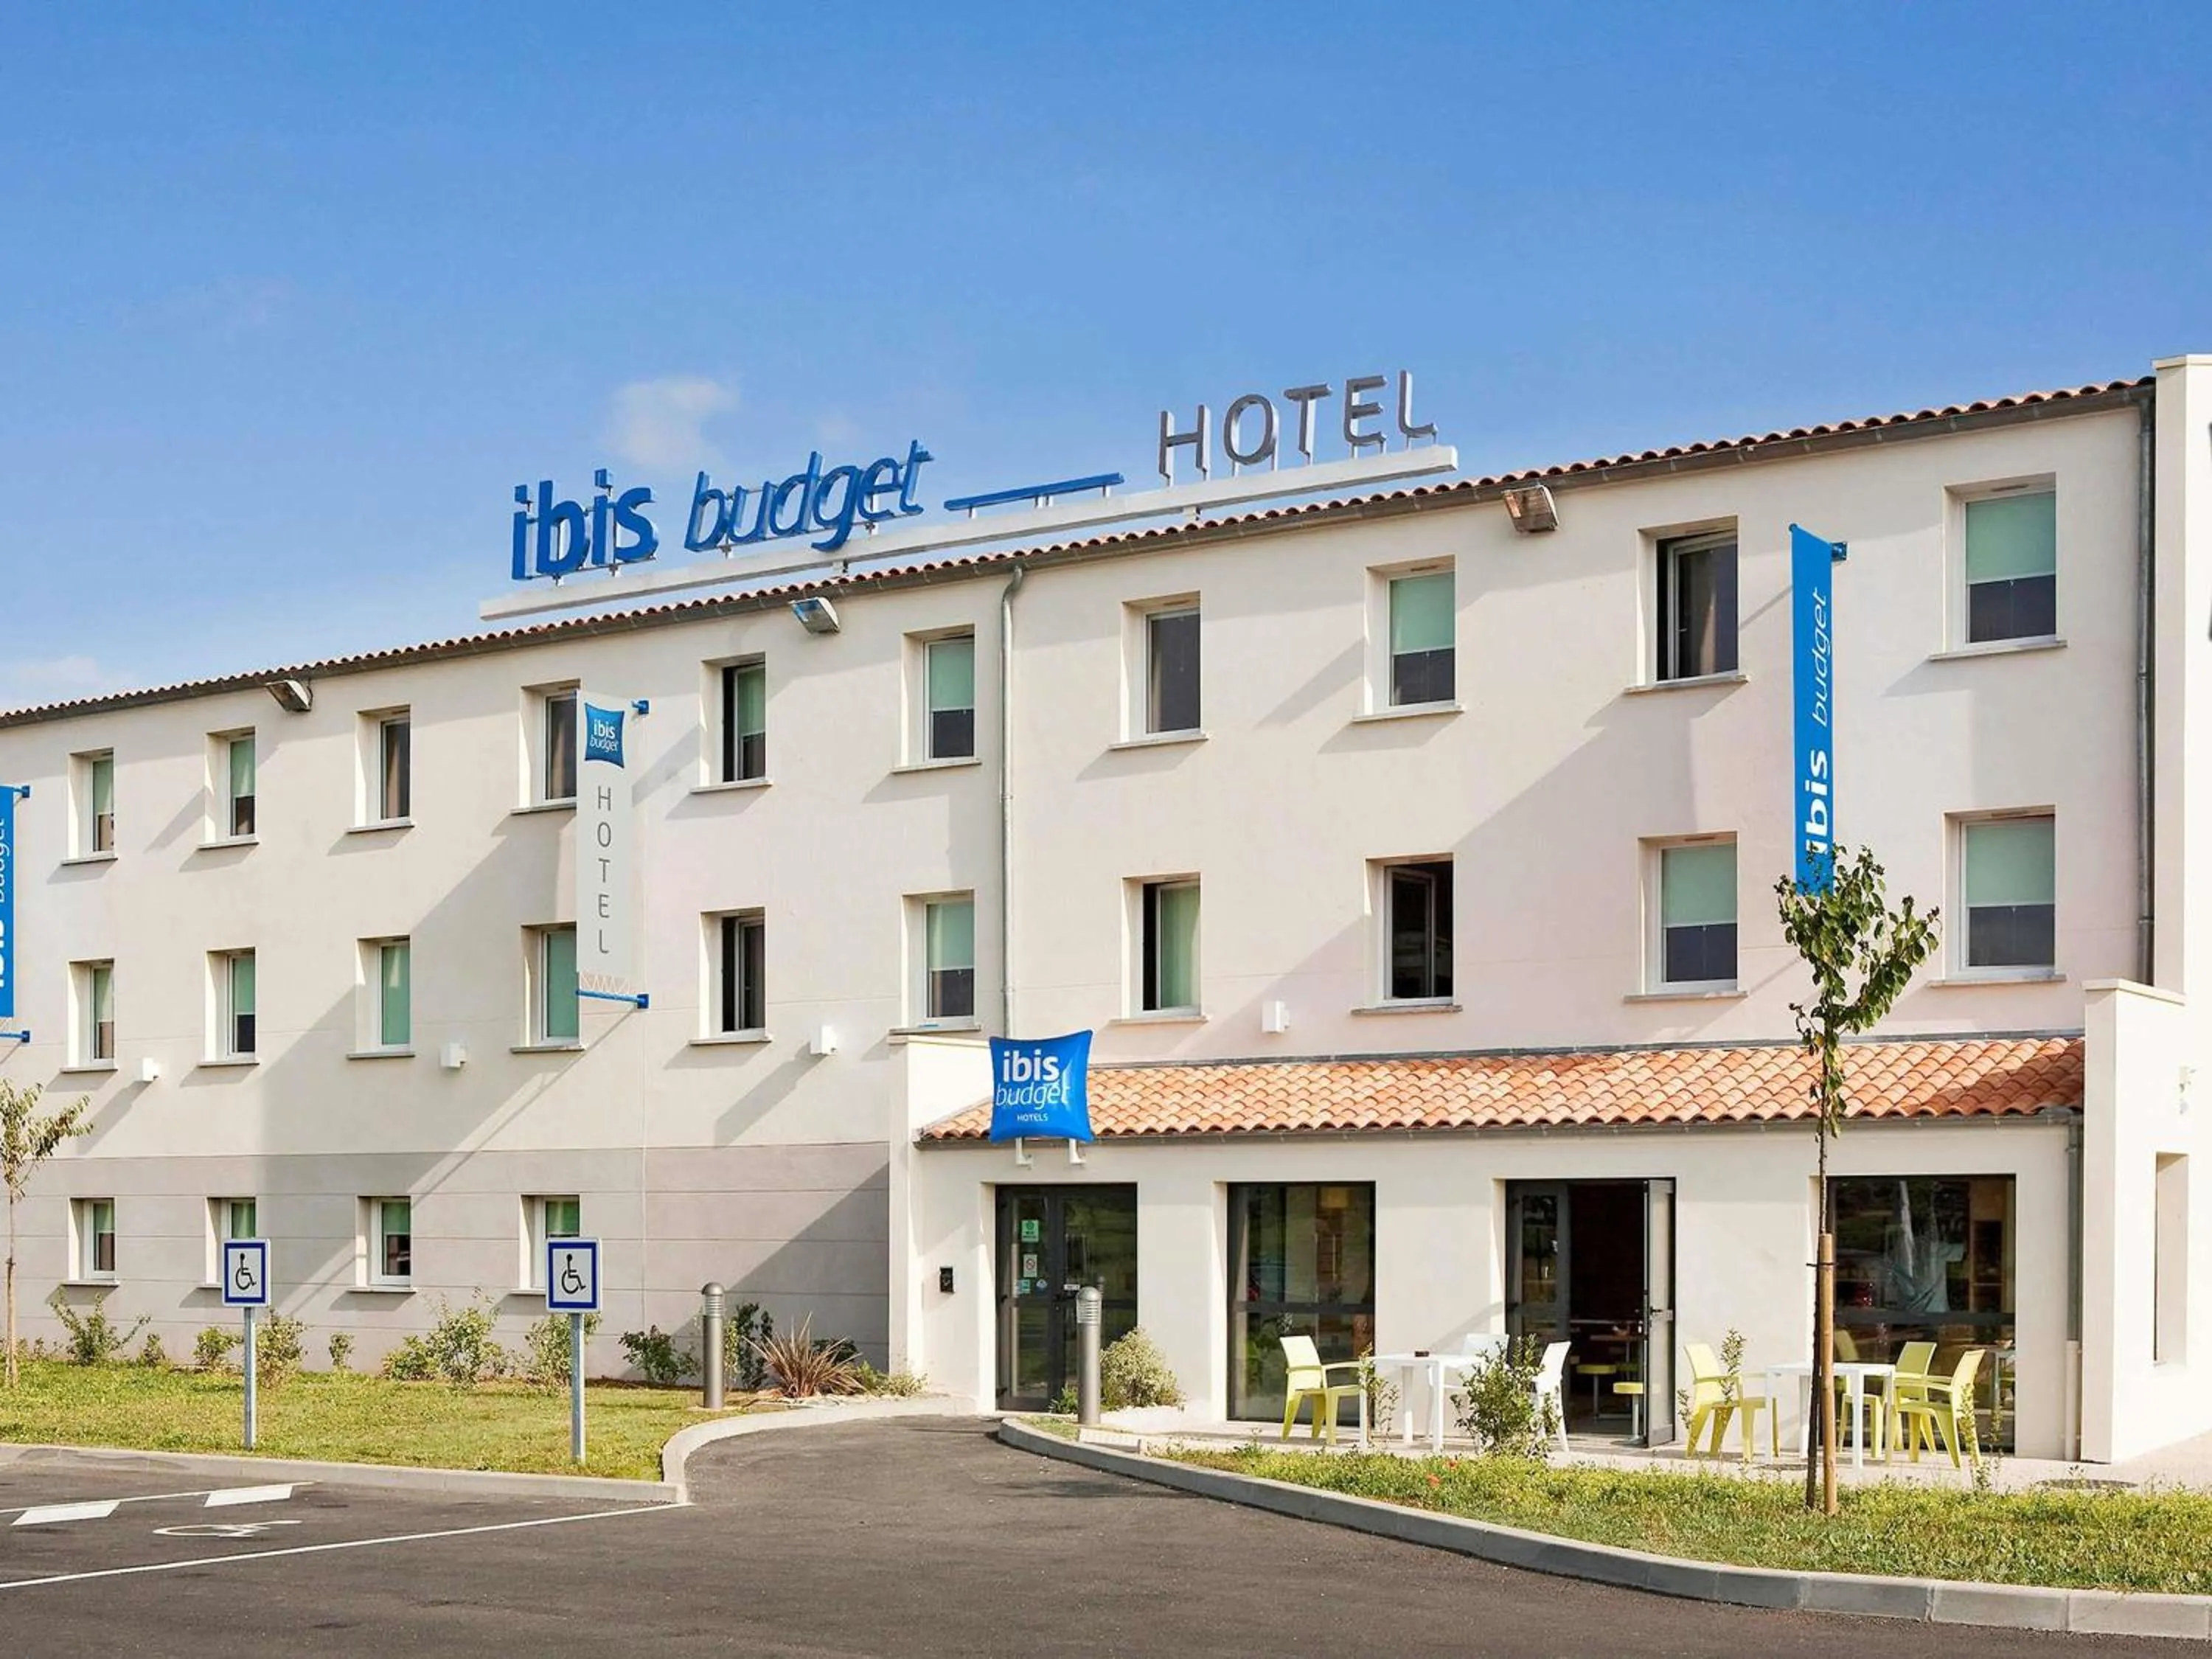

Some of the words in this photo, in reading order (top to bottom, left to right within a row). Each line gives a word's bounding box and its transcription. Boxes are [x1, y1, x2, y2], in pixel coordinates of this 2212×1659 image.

[512, 468, 658, 580] ibis
[684, 439, 934, 552] budget
[1158, 369, 1439, 476] HOTEL
[1812, 586, 1831, 727] budget
[589, 734, 619, 753] budget
[594, 718, 616, 740] ibis
[1805, 748, 1828, 855] ibis
[597, 785, 612, 955] HOTEL
[1003, 1048, 1060, 1082] ibis
[995, 1077, 1071, 1110] budget
[1017, 1113, 1048, 1121] HOTELS
